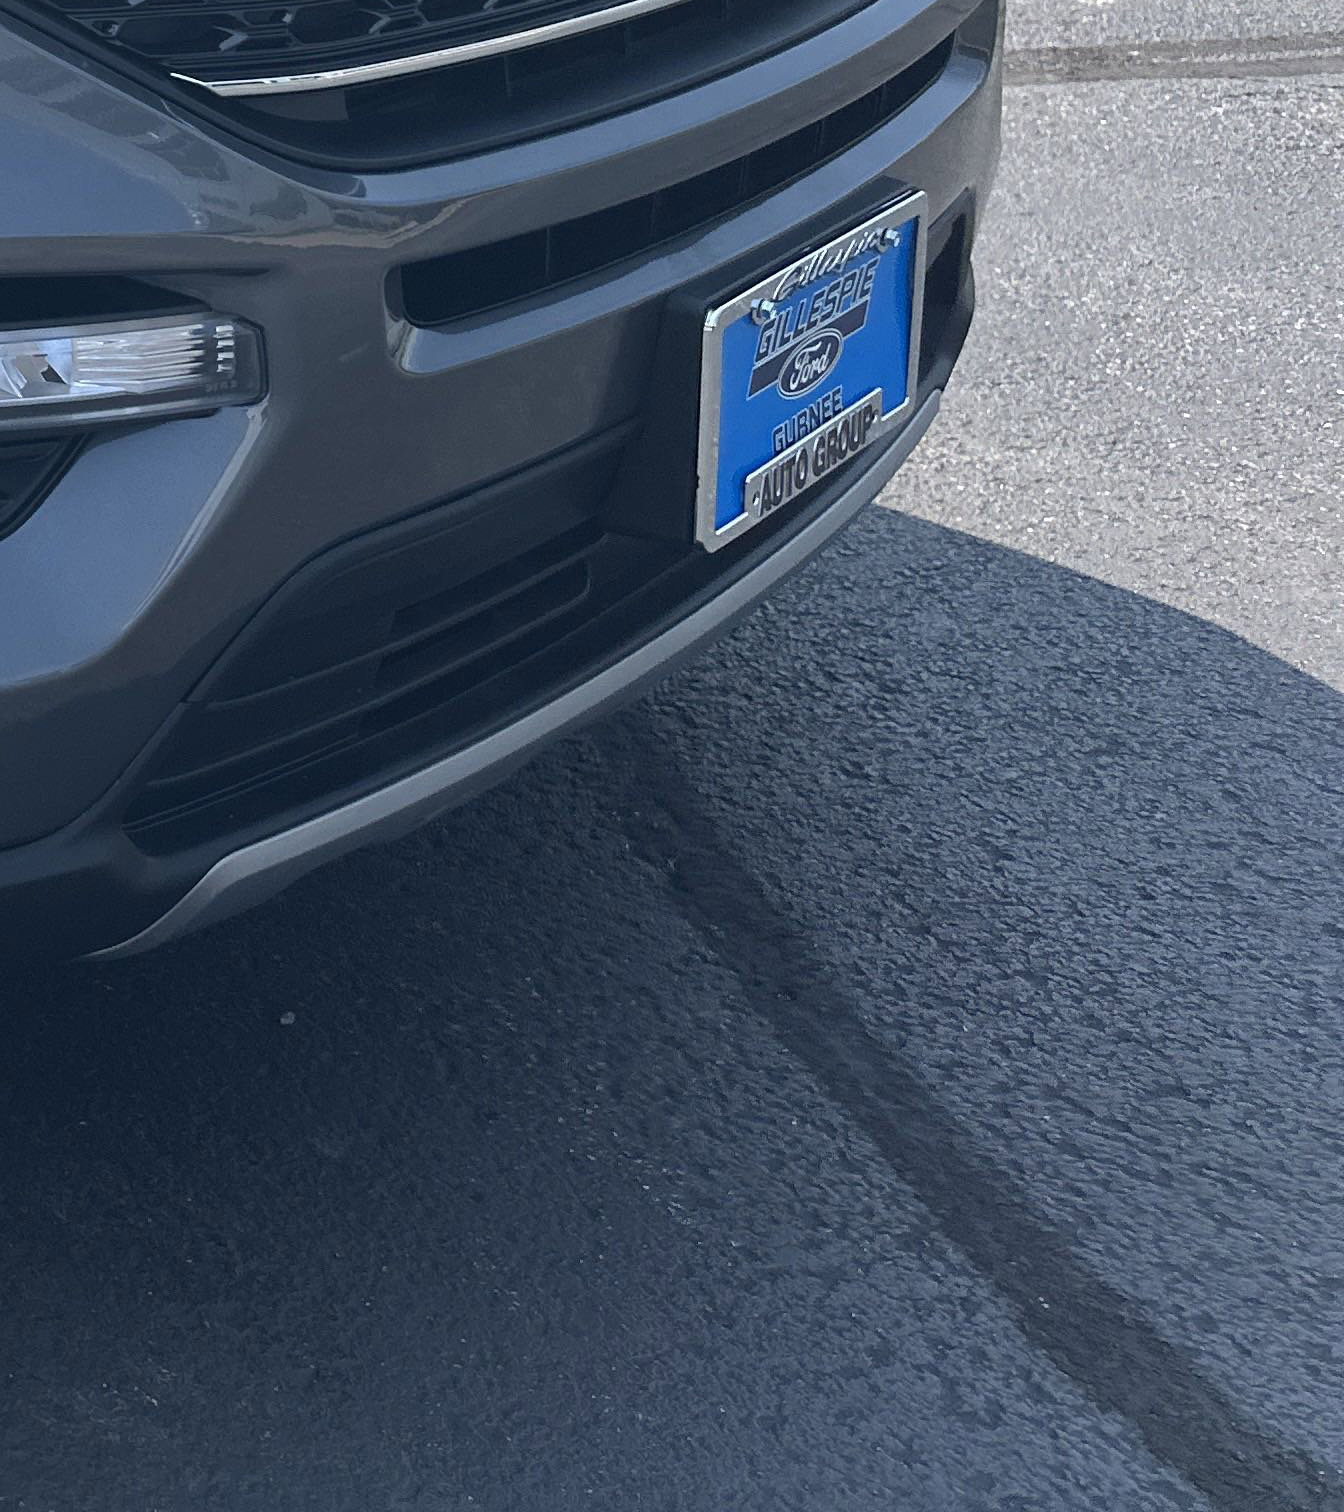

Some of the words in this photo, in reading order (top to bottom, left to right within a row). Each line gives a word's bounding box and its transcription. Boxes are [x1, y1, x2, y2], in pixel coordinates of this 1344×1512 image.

[753, 256, 880, 365] GILLESPIE
[790, 341, 832, 391] Ford
[758, 447, 808, 517] AUTO
[812, 402, 874, 477] GROUP
[772, 385, 843, 456] GURNEE
